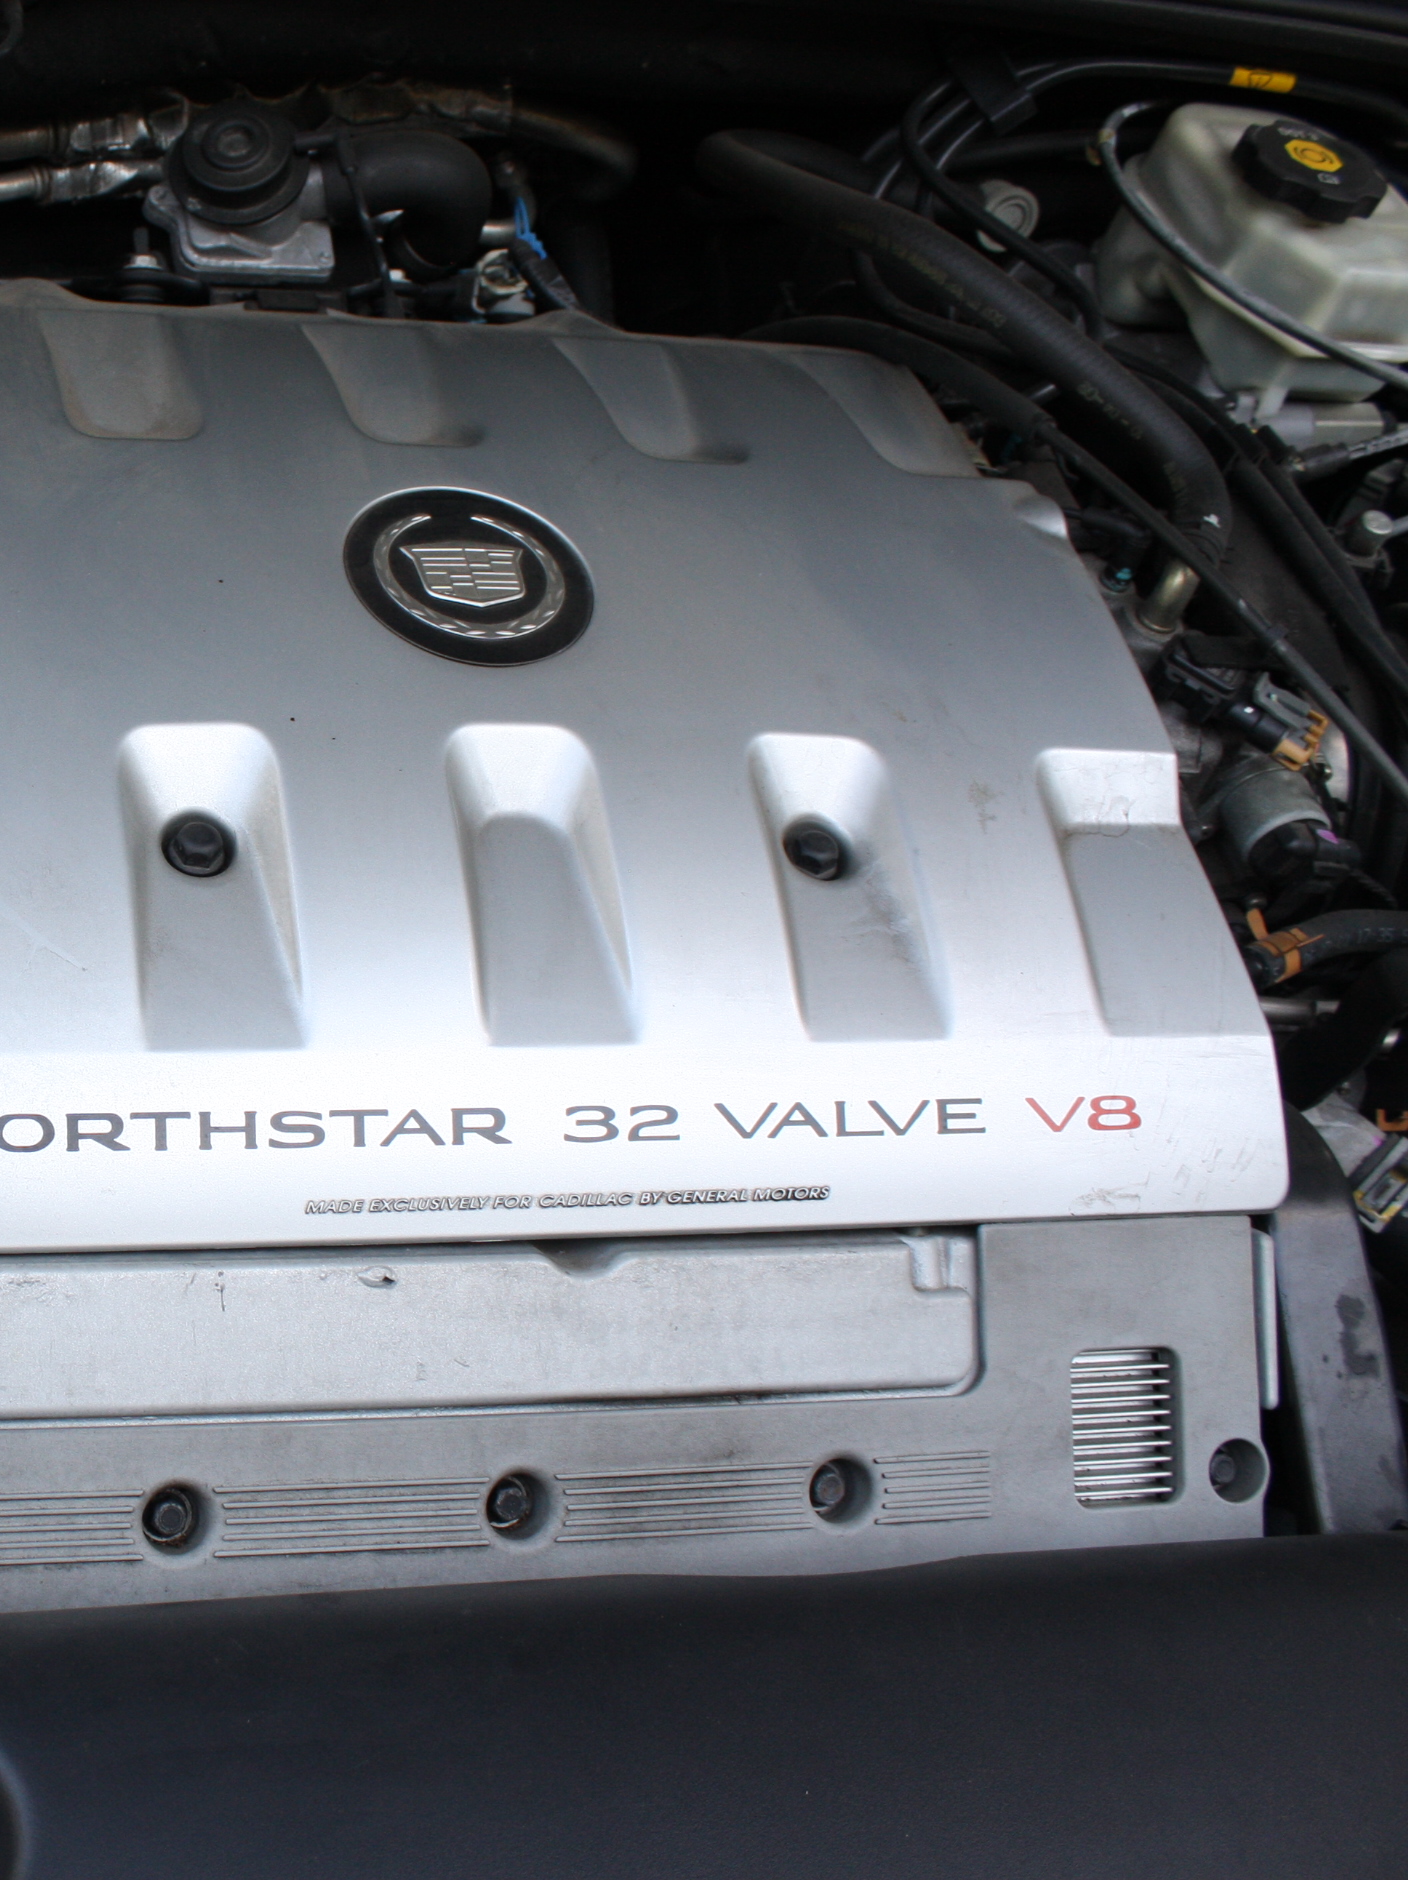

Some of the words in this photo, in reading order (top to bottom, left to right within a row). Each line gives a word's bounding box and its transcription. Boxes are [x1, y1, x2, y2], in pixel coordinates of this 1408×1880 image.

[563, 1104, 680, 1143] 32
[713, 1098, 987, 1140] VALVE
[1024, 1095, 1143, 1132] V8
[305, 1199, 364, 1214] MADE
[368, 1196, 490, 1214] EXCLUSIVELY
[492, 1194, 532, 1210] FOR
[538, 1192, 633, 1208] CADILLAC
[639, 1190, 666, 1206] BY
[667, 1189, 748, 1205] GENERAL
[750, 1186, 831, 1202] MOTORS
